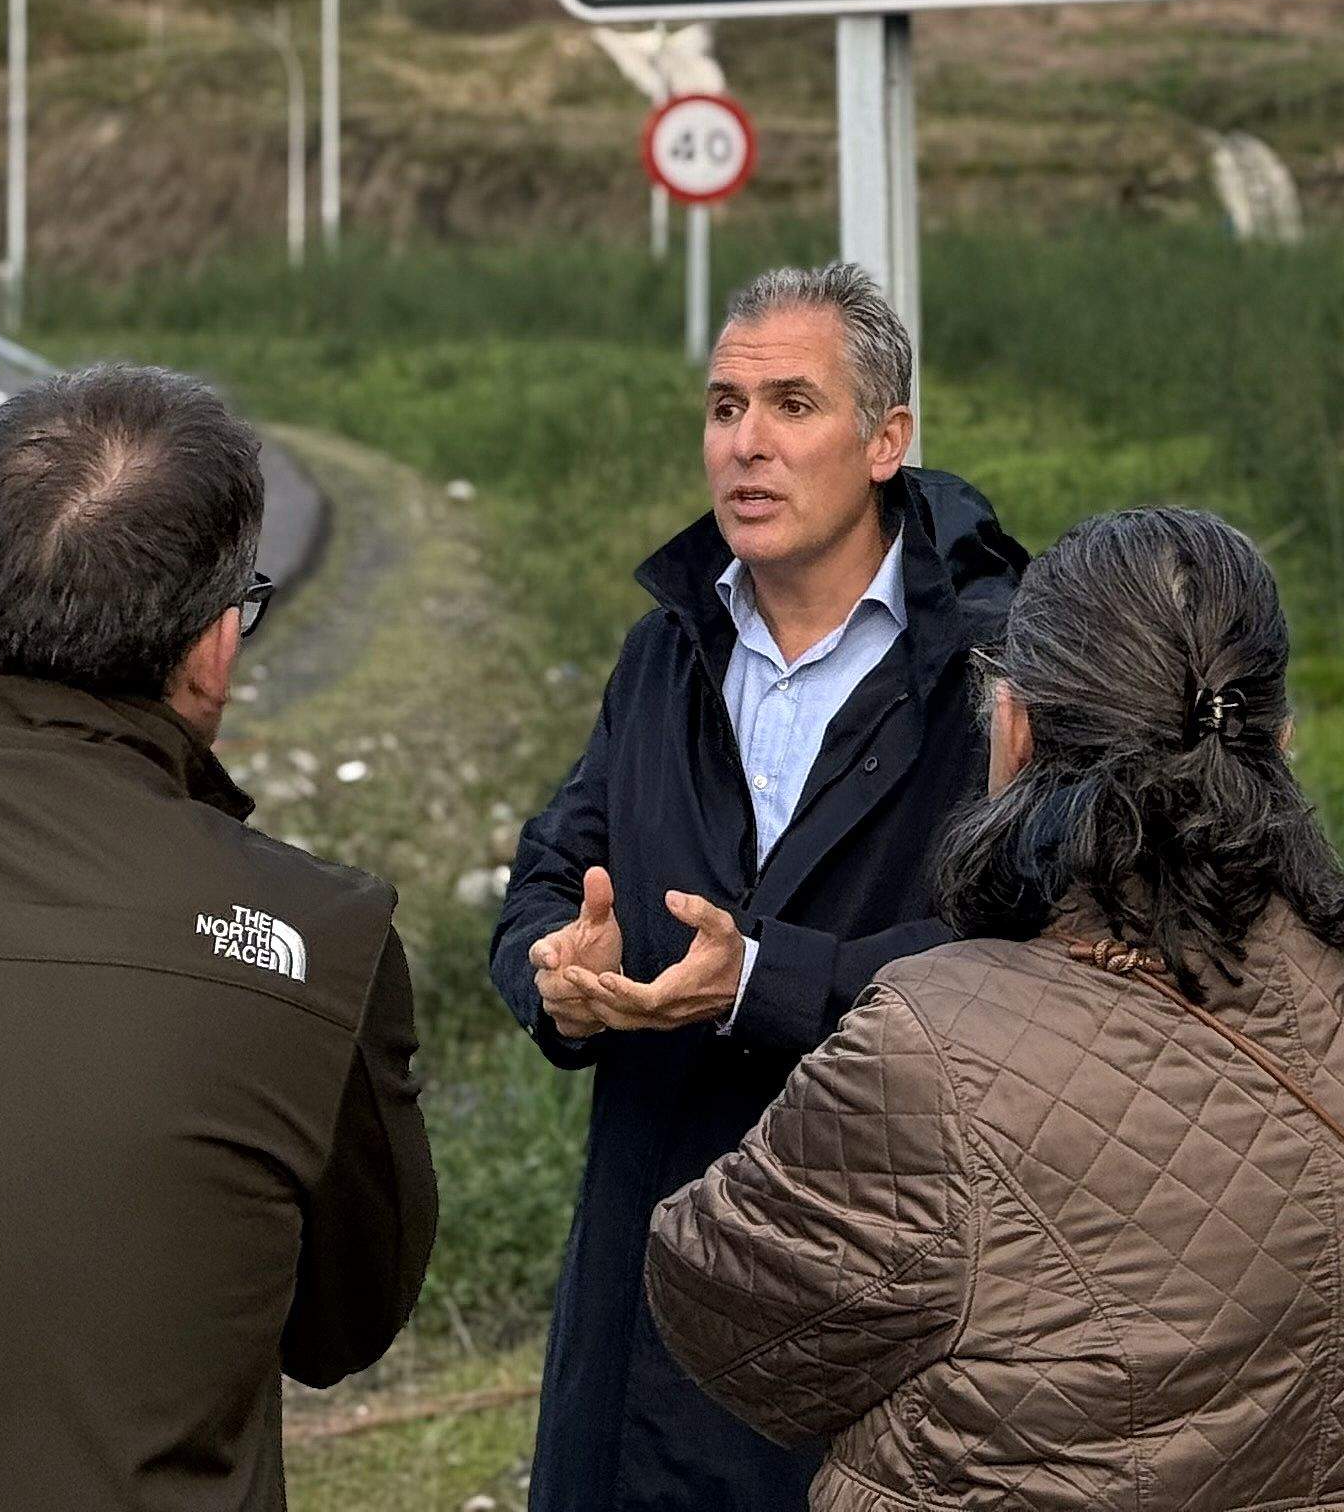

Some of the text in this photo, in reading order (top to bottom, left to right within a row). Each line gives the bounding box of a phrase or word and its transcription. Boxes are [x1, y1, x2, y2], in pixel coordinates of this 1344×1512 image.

[670, 128, 733, 167] 40
[196, 914, 271, 949] NORTH
[231, 904, 272, 930] THE
[213, 937, 271, 969] FACE
